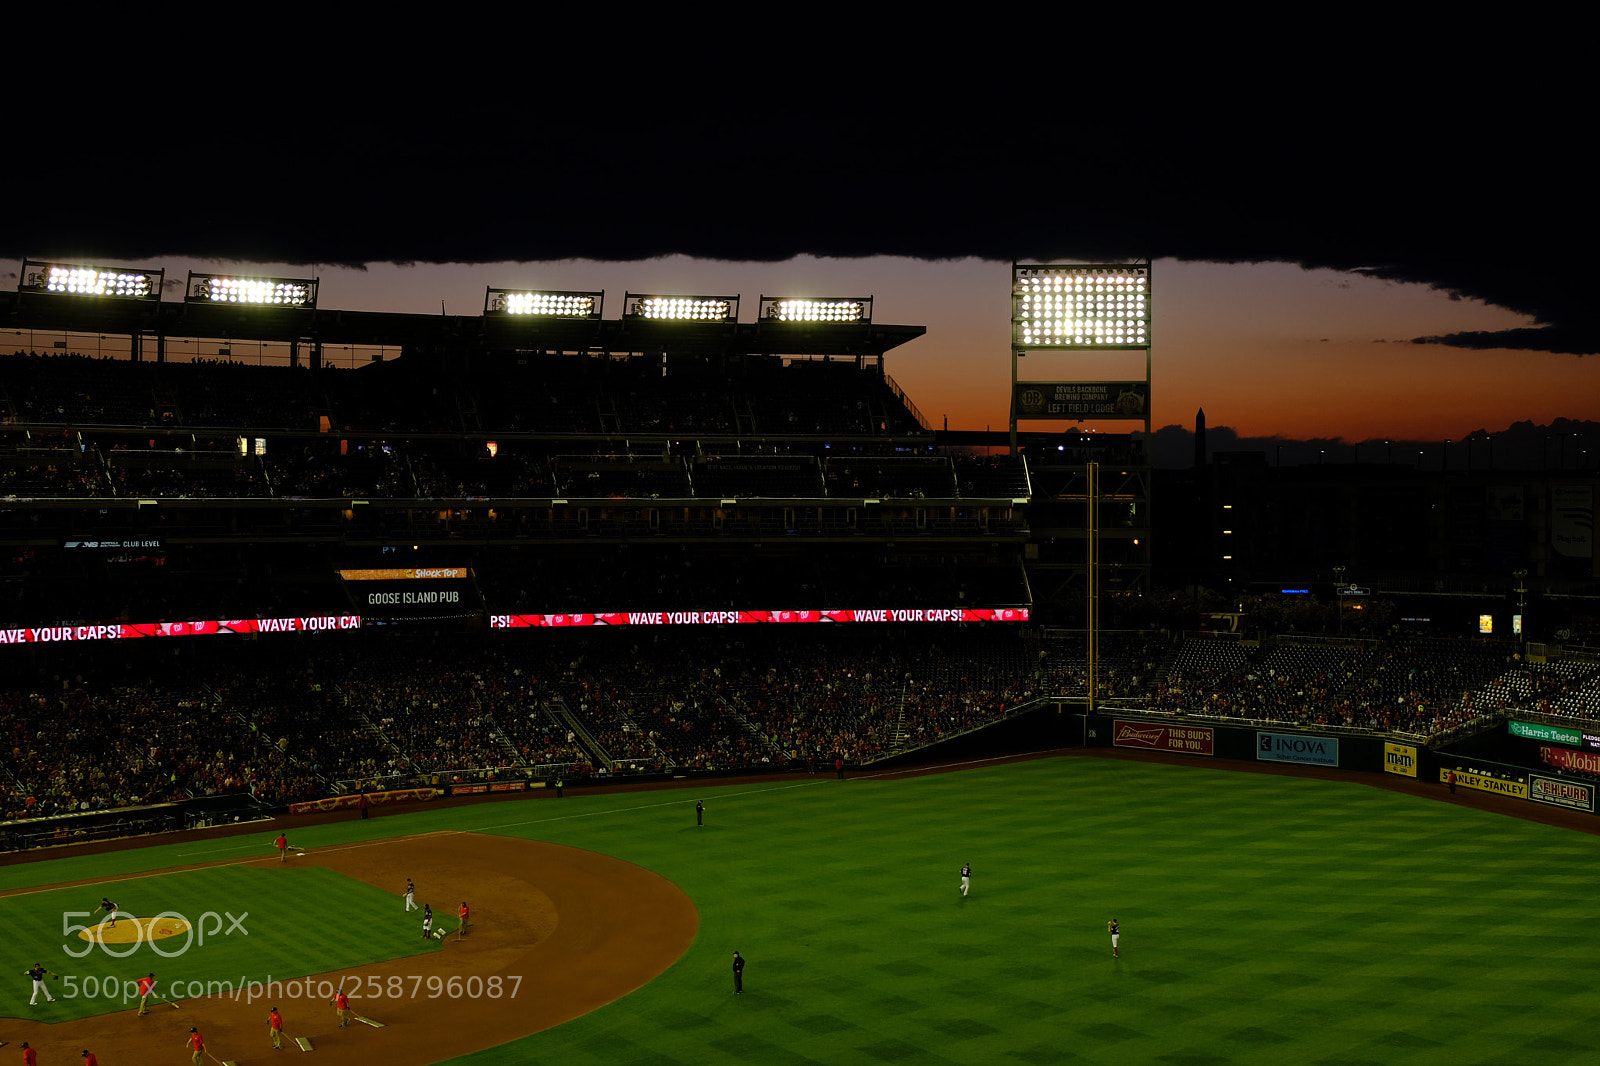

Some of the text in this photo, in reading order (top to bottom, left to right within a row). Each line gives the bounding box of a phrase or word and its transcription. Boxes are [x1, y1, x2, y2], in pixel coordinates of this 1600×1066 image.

[1048, 403, 1115, 413] LEFT FIELD LODGE
[441, 569, 458, 577] TOP
[368, 591, 459, 604] GOOSE ISLAND PUB
[628, 611, 739, 624] WAVE YOUR CAPS!
[854, 609, 962, 622] WAVE YOUR CAPS!
[258, 616, 361, 632] WAVE YOUR CA
[31, 627, 72, 642] YOUR
[77, 624, 121, 640] CAPS!
[1121, 730, 1160, 740] Budweiser
[1168, 728, 1211, 741] THIS BUD'S
[1521, 726, 1579, 743] Harris Teeter
[1168, 739, 1203, 750] FOR YOU.
[1276, 739, 1325, 754] INOVA
[1483, 779, 1524, 795] STANLEY
